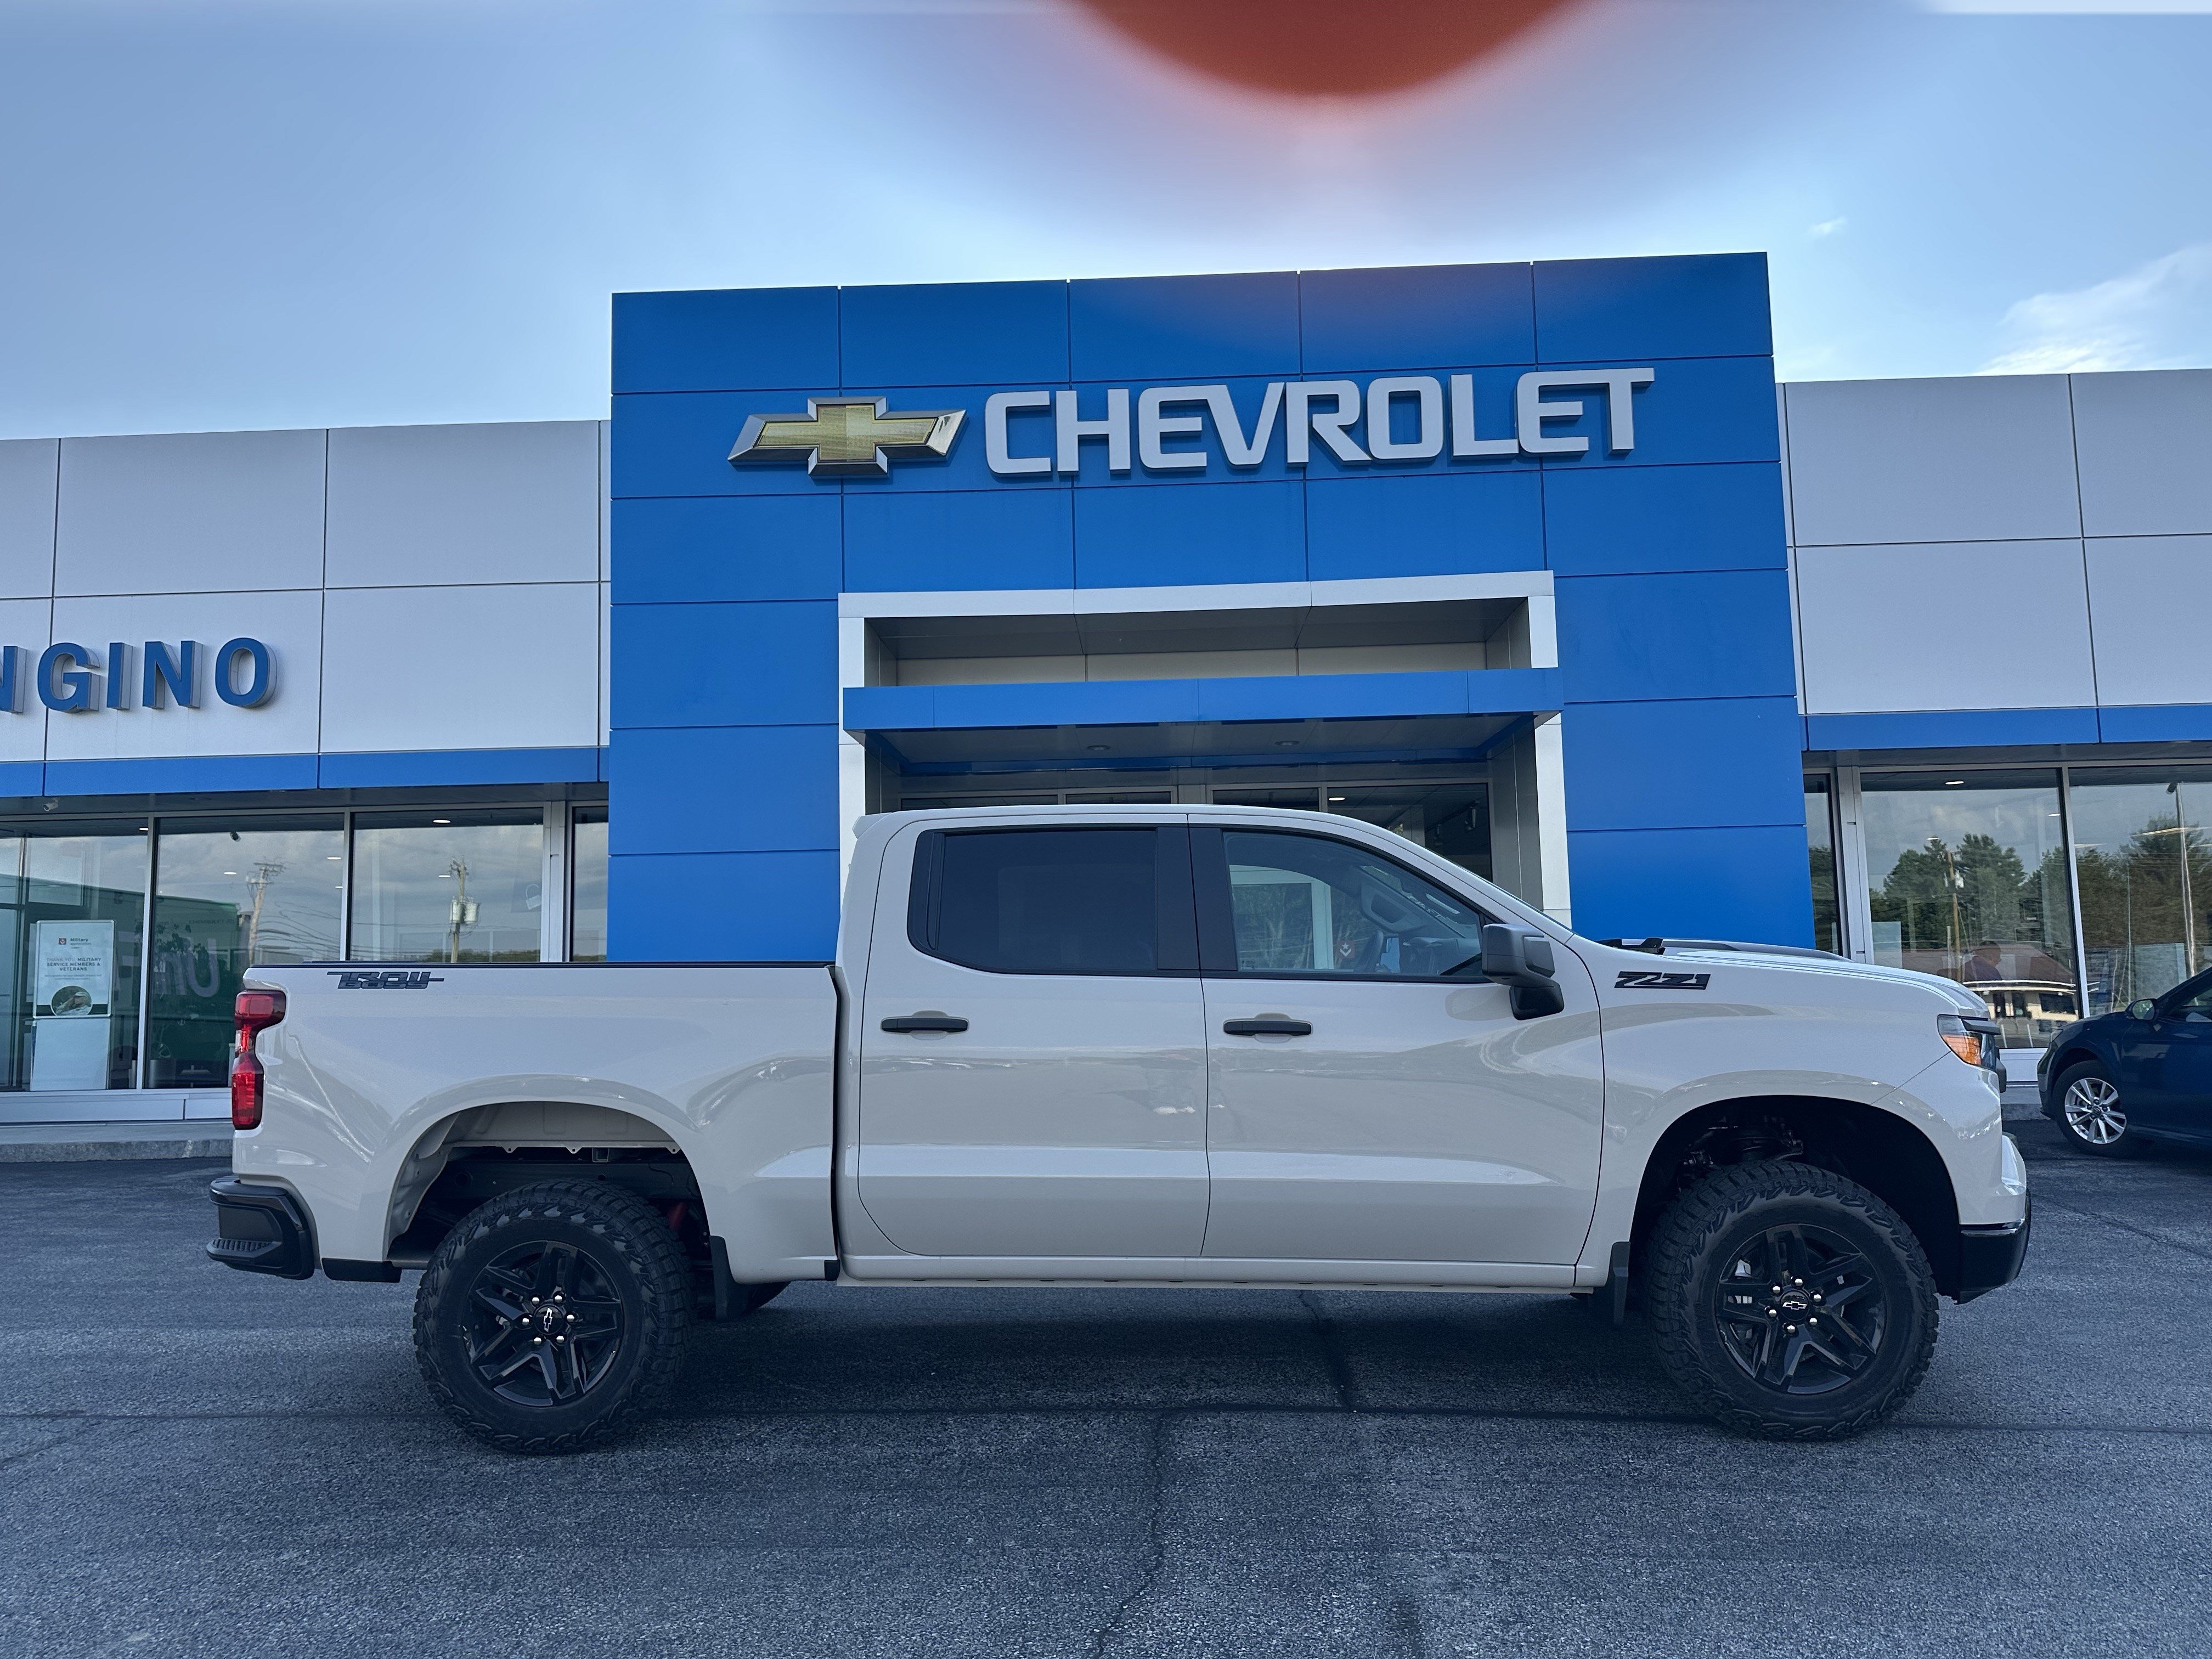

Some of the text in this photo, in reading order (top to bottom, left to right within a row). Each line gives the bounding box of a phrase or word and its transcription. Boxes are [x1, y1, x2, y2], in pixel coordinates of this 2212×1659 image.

[985, 367, 1655, 476] CHEVROLET
[327, 971, 445, 981] TRAIL
[1614, 971, 1711, 990] Z71
[337, 980, 428, 989] BOSS
